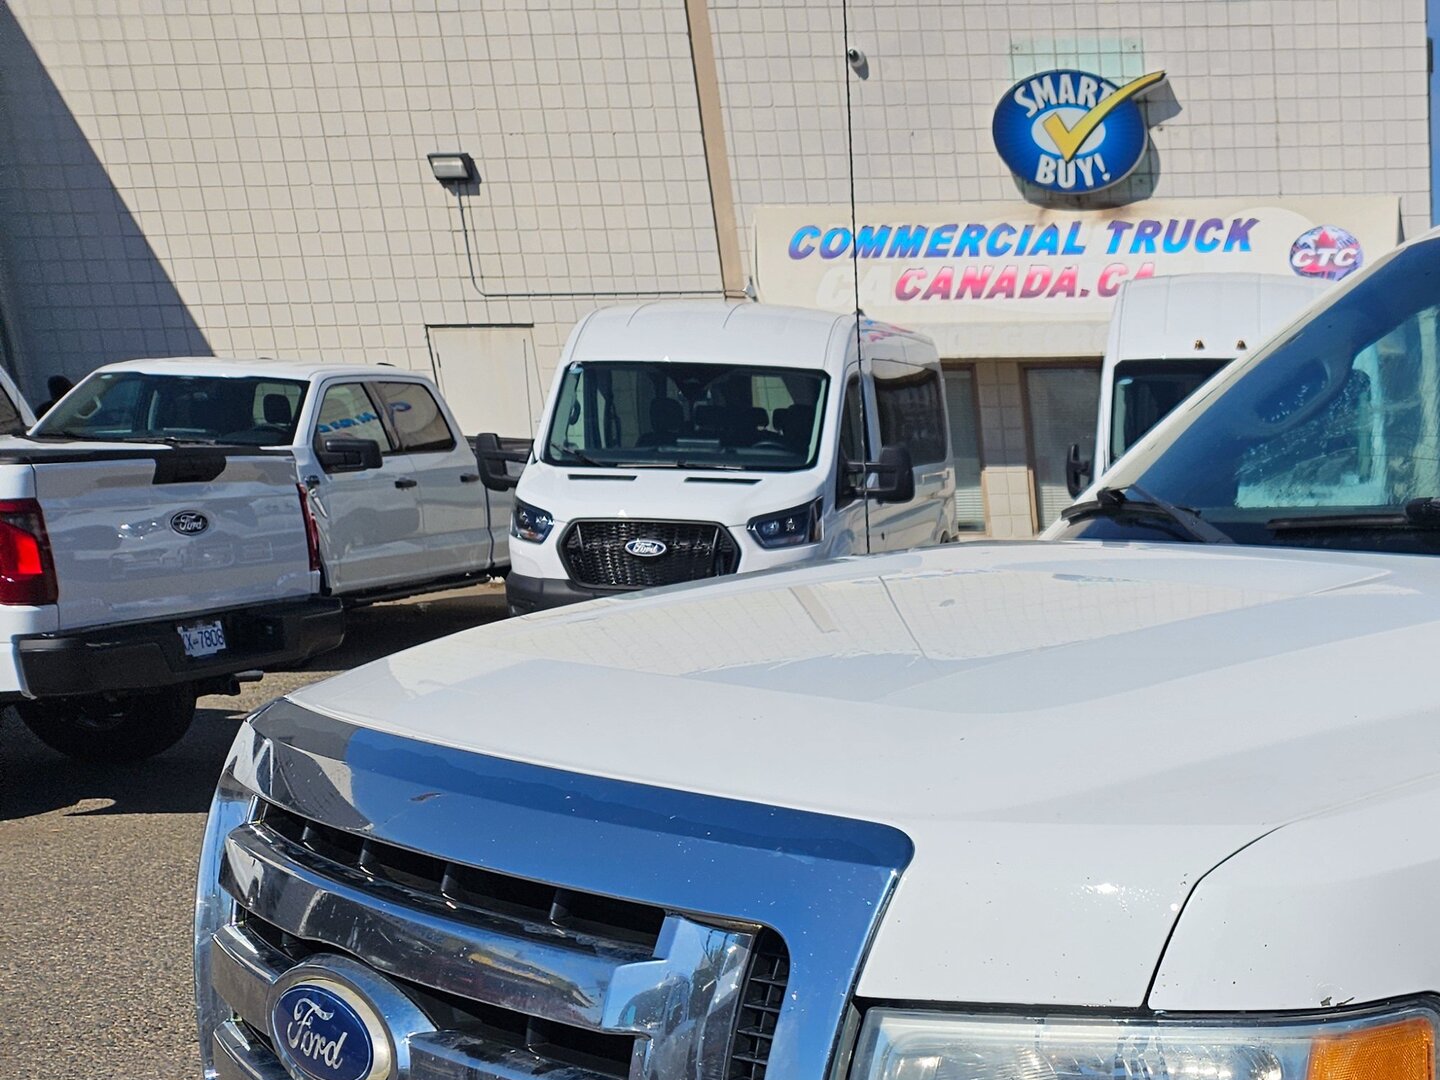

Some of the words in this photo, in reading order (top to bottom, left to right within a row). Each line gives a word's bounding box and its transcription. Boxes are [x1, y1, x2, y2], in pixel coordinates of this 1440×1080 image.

[1014, 74, 1117, 118] SMART
[1035, 153, 1111, 189] BUY!
[788, 222, 1087, 260] COMMERCIAL
[1105, 217, 1260, 254] TRUCK
[1292, 247, 1358, 268] CTC
[287, 998, 348, 1070] Ford
